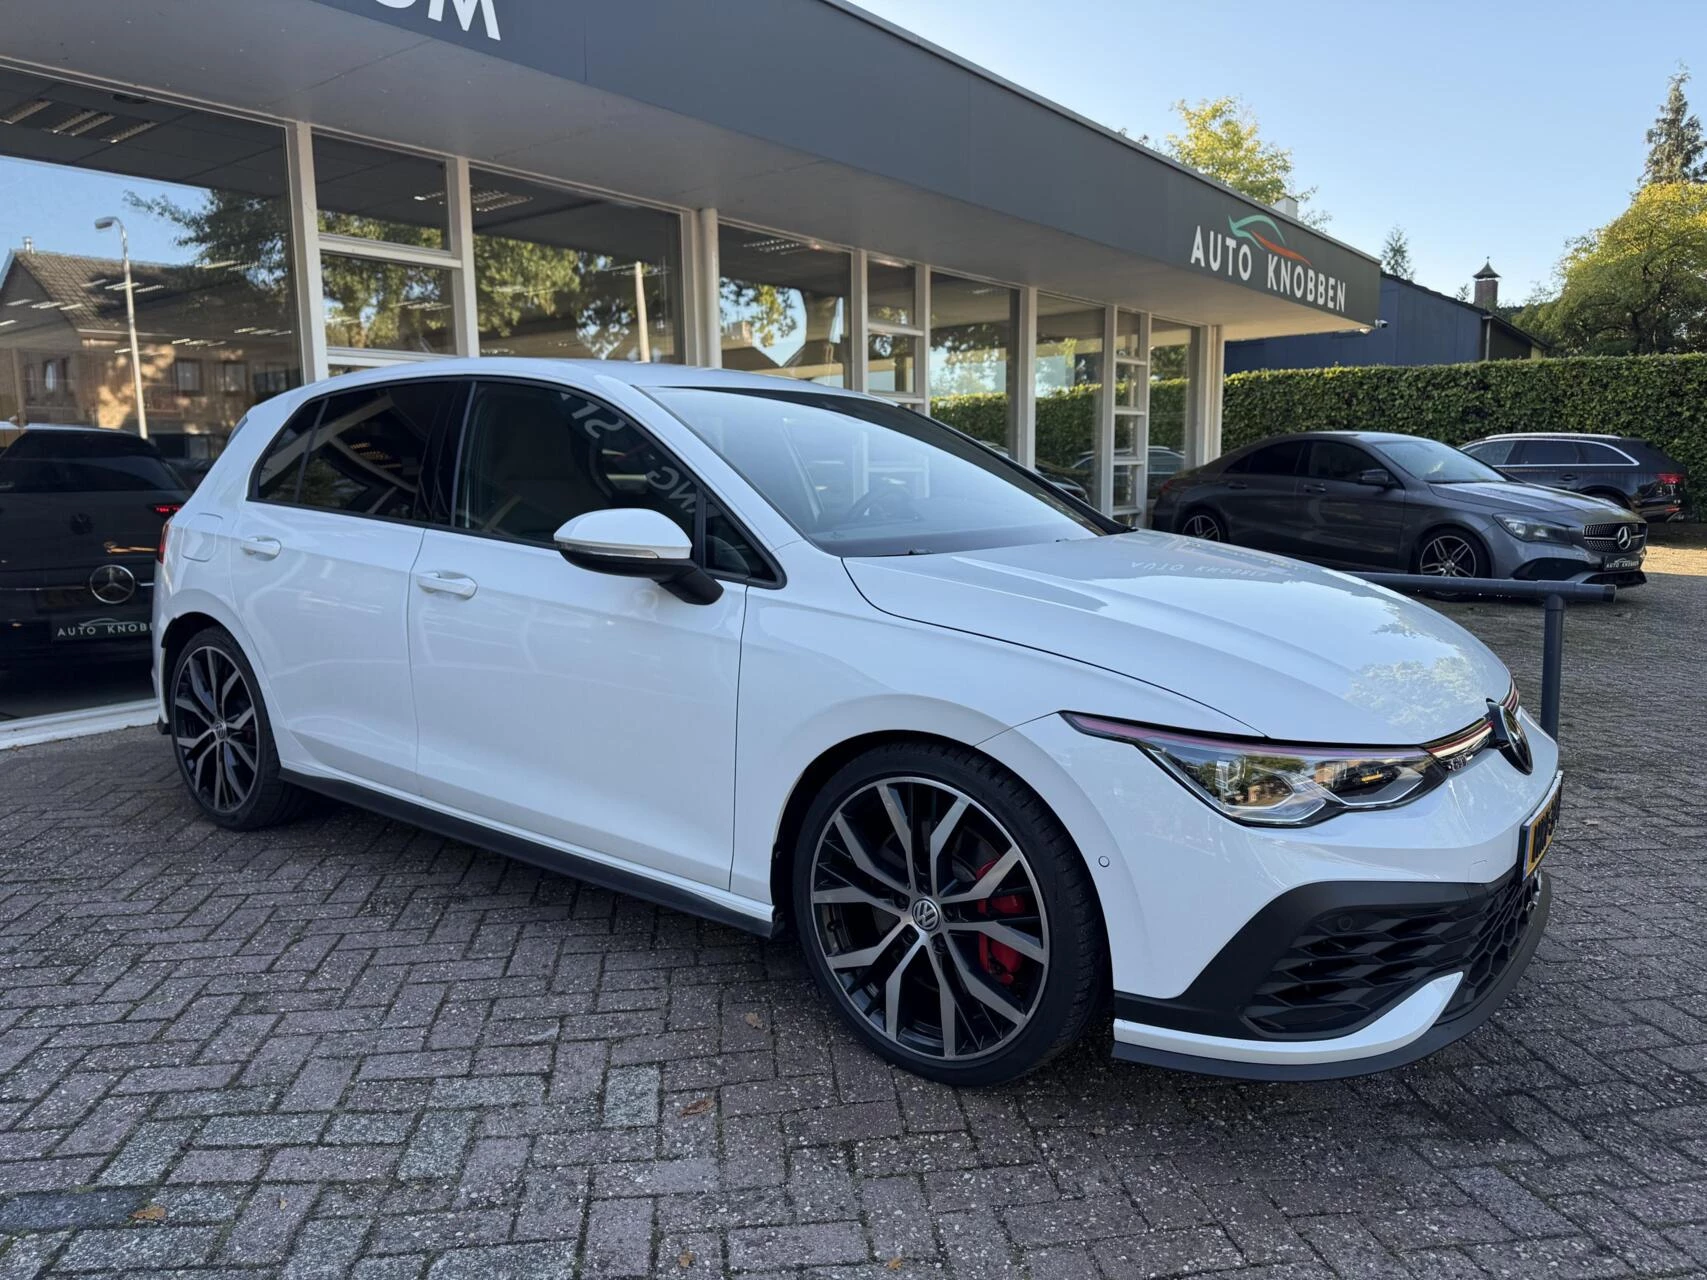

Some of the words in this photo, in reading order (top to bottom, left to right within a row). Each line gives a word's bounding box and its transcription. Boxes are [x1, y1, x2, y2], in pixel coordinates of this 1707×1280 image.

[1190, 225, 1252, 281] AUTO
[1267, 253, 1346, 312] KNOBBEN
[57, 626, 97, 637] AUTO
[107, 623, 153, 634] KNOB
